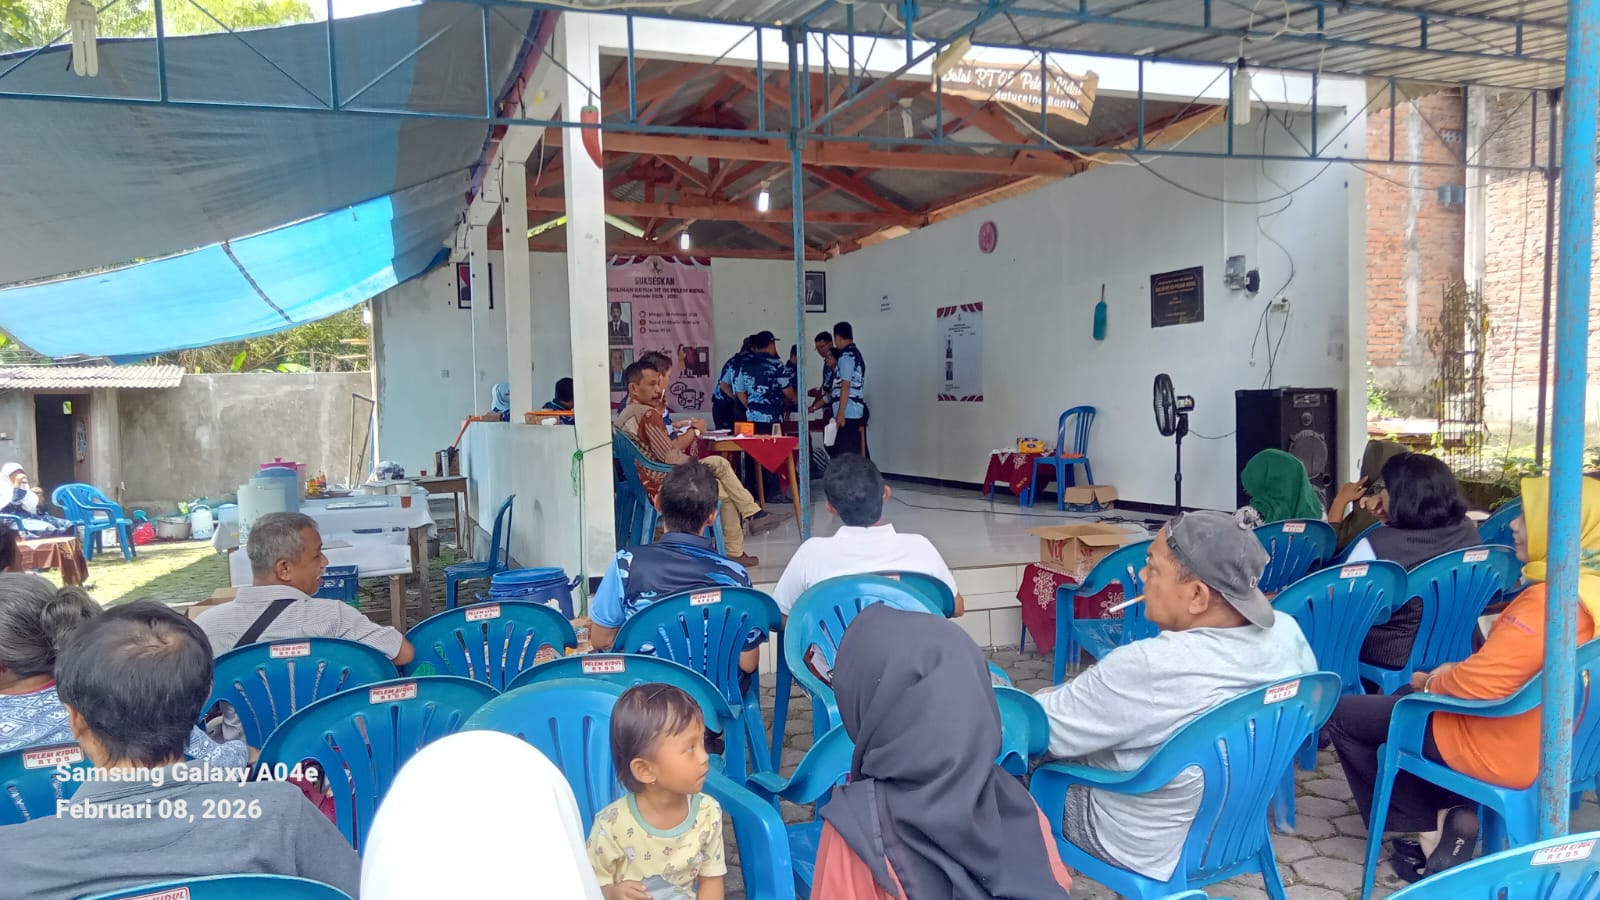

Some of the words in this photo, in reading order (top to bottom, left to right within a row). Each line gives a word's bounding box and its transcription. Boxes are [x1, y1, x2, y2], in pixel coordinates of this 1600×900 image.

[975, 68, 1001, 89] RT
[634, 276, 675, 286] SUKSESKAN
[27, 751, 54, 760] PELEM
[55, 747, 80, 757] KIDUL
